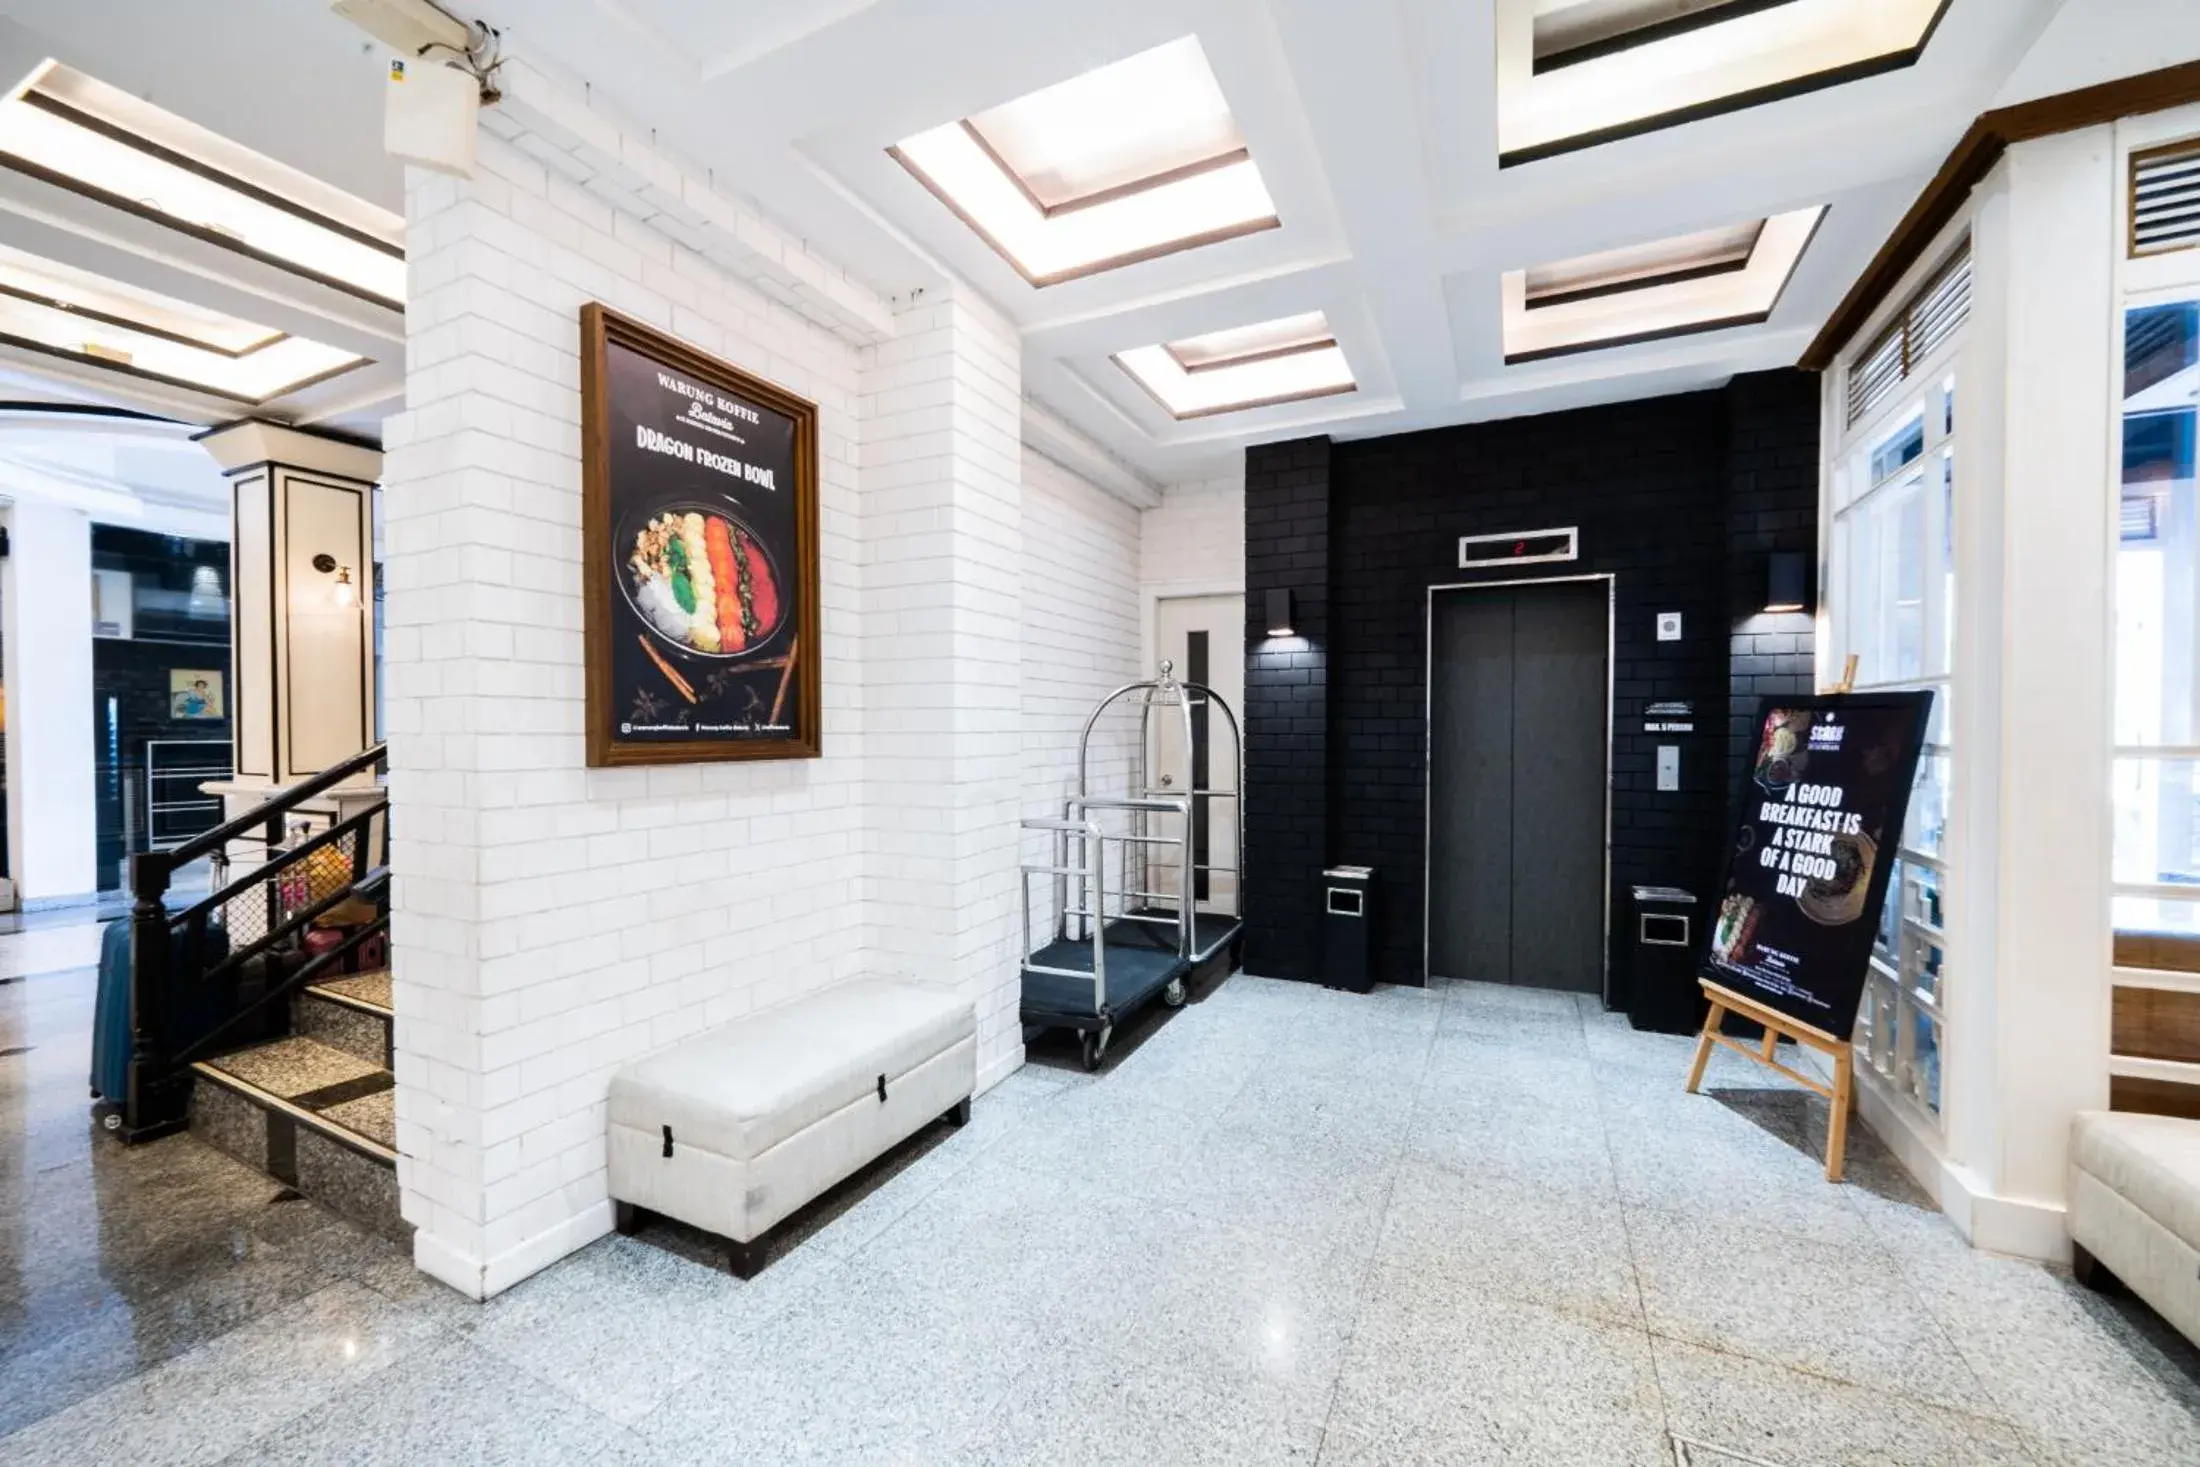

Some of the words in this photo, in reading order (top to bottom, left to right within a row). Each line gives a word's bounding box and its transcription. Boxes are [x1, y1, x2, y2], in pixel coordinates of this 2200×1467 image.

[657, 372, 714, 406] WARUNG
[716, 396, 760, 425] KOFFIE
[636, 424, 694, 462] DRAGON
[696, 447, 742, 479] FROZEN
[744, 464, 776, 491] BOWL
[1784, 782, 1797, 803] A
[1798, 783, 1843, 808] GOOD
[1760, 801, 1844, 832] BREAKFAST
[1842, 812, 1863, 835] IS
[1772, 826, 1784, 847] A
[1784, 828, 1835, 856] STARK
[1760, 846, 1780, 868] OF
[1778, 851, 1791, 871] A
[1791, 852, 1837, 881] GOOD
[1776, 873, 1808, 899] DAY
